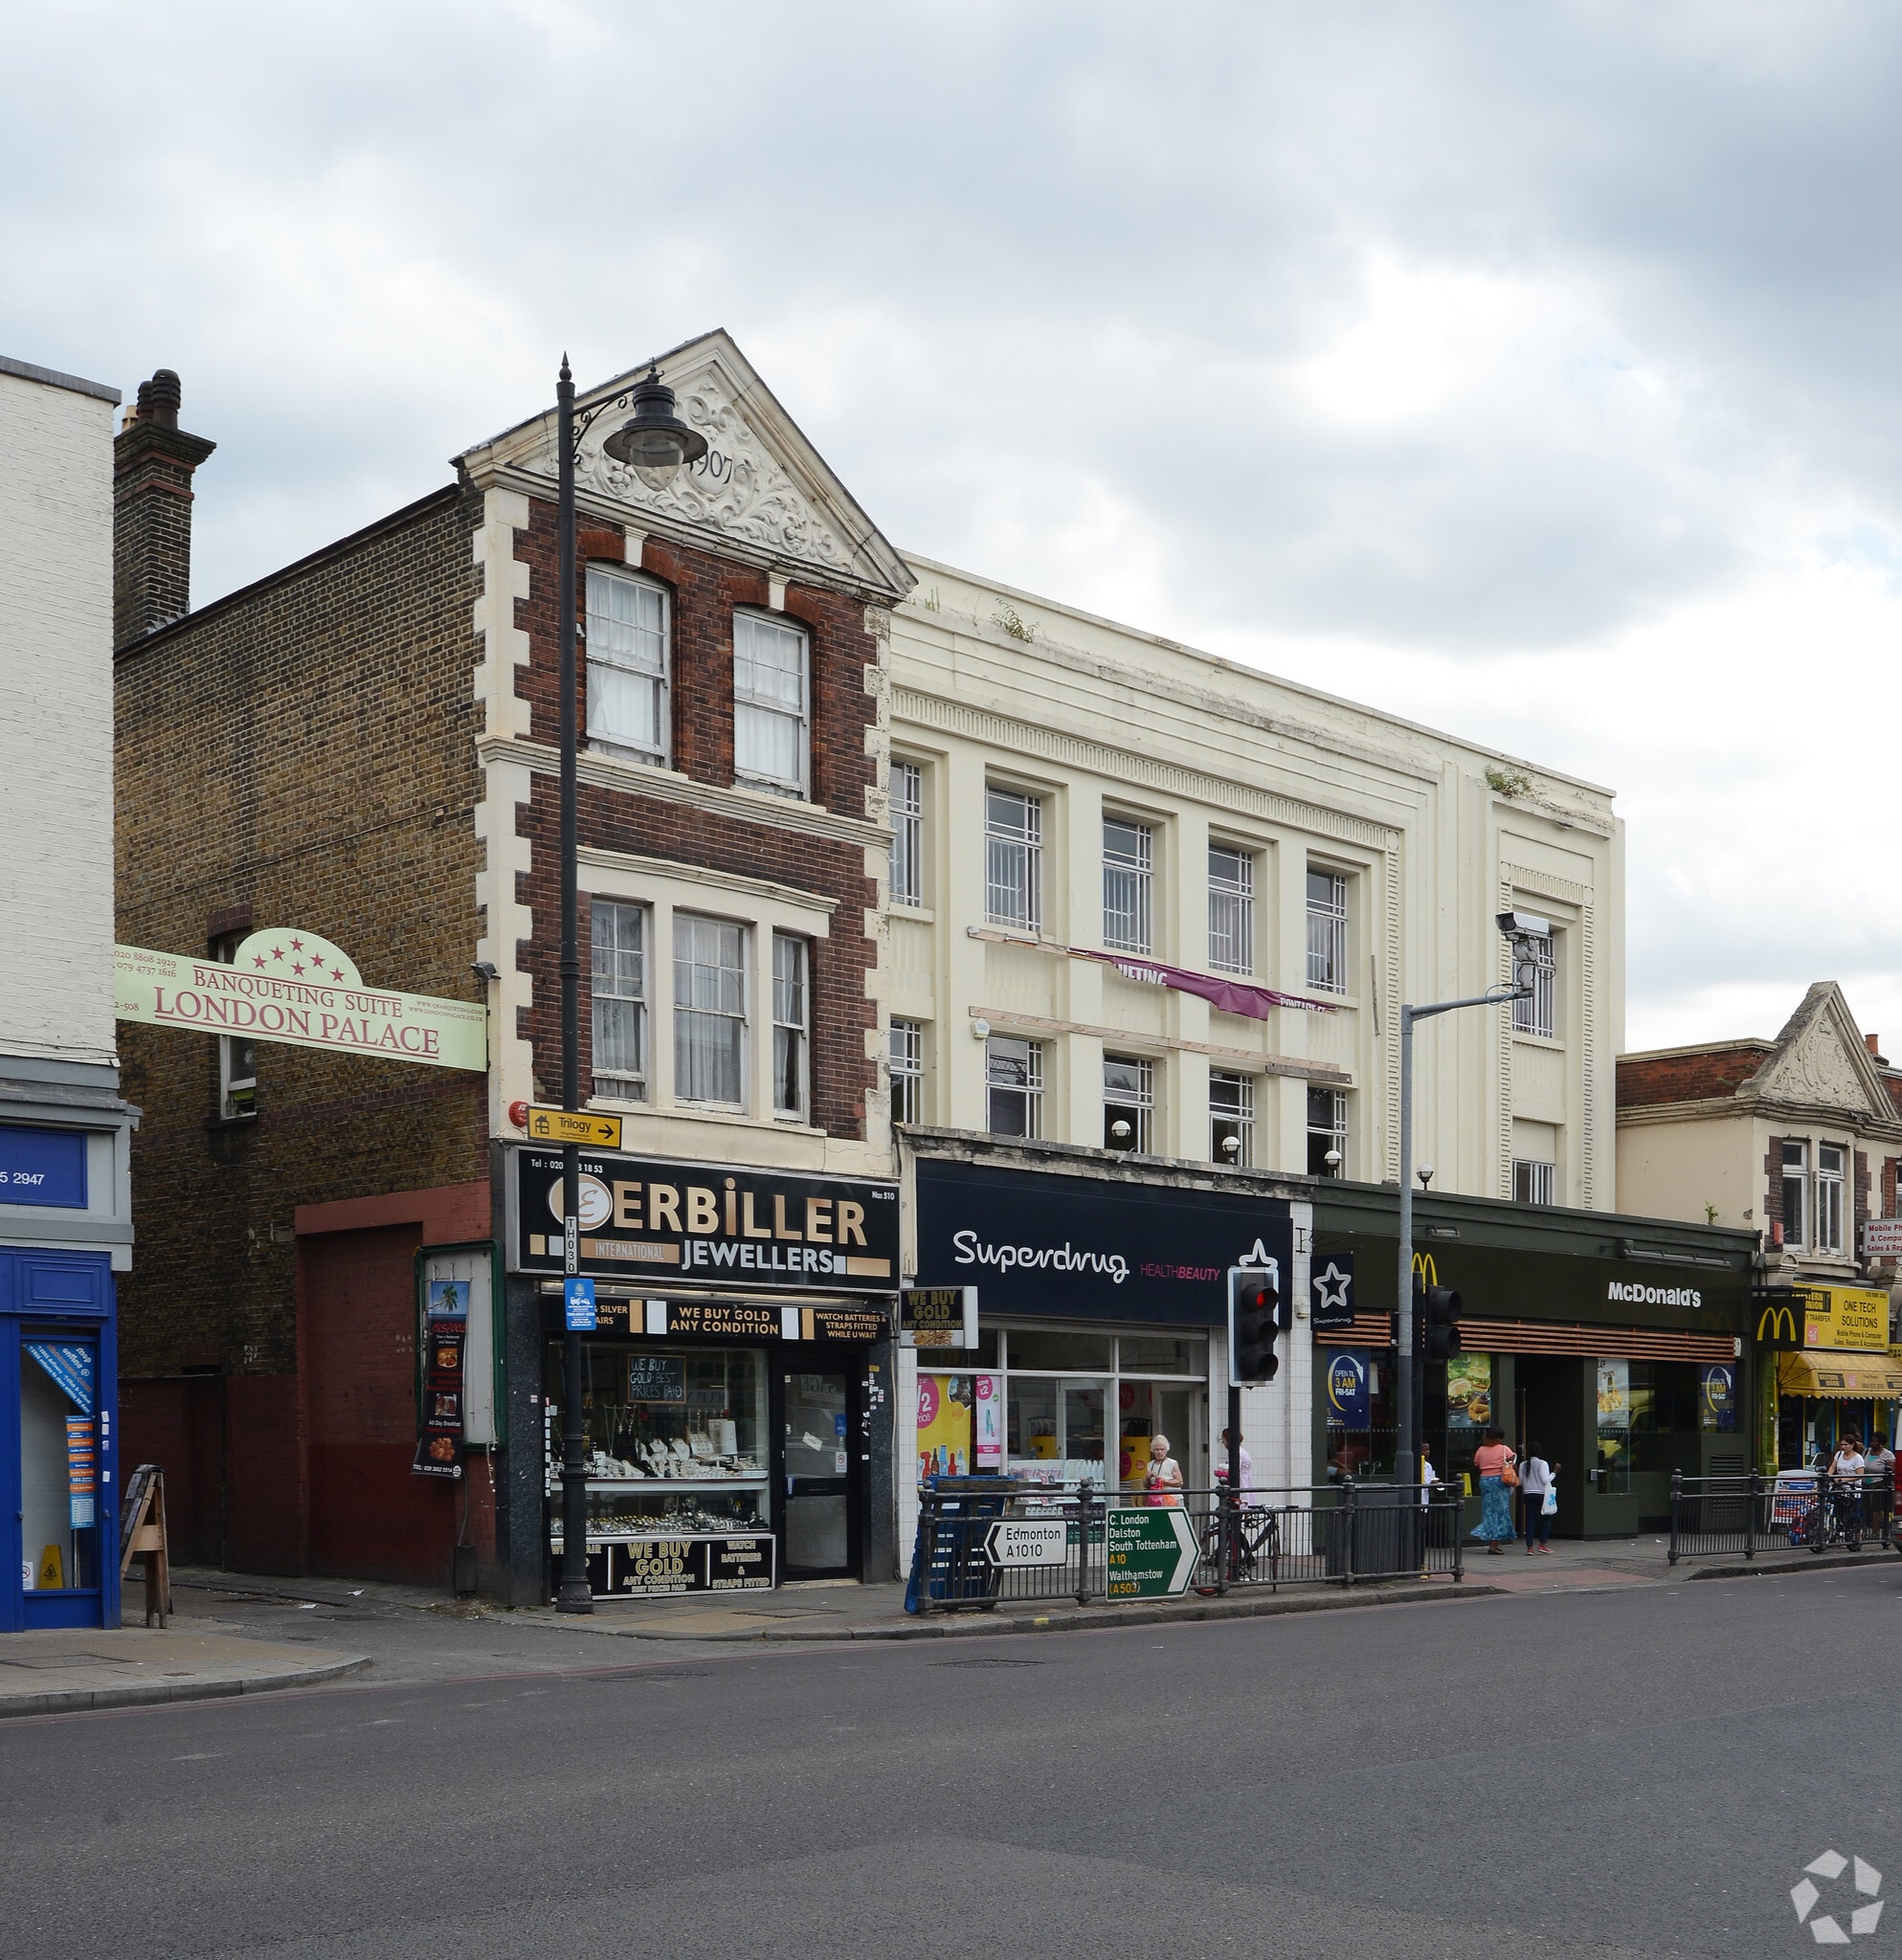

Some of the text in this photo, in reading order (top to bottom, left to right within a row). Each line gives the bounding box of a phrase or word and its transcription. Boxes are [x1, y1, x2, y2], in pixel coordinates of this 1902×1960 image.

[115, 950, 176, 969] 020 8808 2929
[118, 962, 176, 977] 079 4737 1616
[193, 969, 402, 1017] BANQUETING SUITE
[154, 986, 439, 1054] LONDON PALACE
[558, 1117, 592, 1133] Trilogy
[531, 1159, 542, 1168] Tel
[549, 1161, 564, 1169] 020
[584, 1164, 593, 1172] 18
[593, 1165, 603, 1173] 53
[12, 1172, 45, 1185] 2947
[884, 1192, 895, 1200] 510
[595, 1239, 833, 1273] INTERNATIONAL JEWELLERS
[953, 1230, 1130, 1283] Superdrug
[907, 1291, 956, 1305] WE BUY
[1608, 1281, 1701, 1308] McDonald's
[600, 1305, 628, 1314] SILVER
[913, 1305, 951, 1320] GOLD
[1844, 1301, 1876, 1313] ONE TECH
[679, 1307, 770, 1322] WE BUY GOLD
[844, 1314, 881, 1323] BATTERIES
[670, 1320, 778, 1334] ANY CONDITION
[826, 1322, 853, 1330] STRAPS
[920, 1320, 962, 1328] CONDITION
[1842, 1316, 1878, 1328] SOLUTIONS
[63, 1348, 82, 1369] online
[77, 1347, 91, 1363] shop
[632, 1359, 667, 1370] WE BUY
[1335, 1377, 1355, 1388] 3 AM
[632, 1385, 660, 1397] PRICES
[664, 1385, 682, 1398] PAID
[980, 1386, 989, 1395] £2
[1109, 1514, 1149, 1526] C. London
[1006, 1527, 1061, 1541] Edmonton
[1109, 1528, 1141, 1539] Dalston
[550, 1545, 602, 1554] WE AIR
[627, 1541, 692, 1559] WE BUY
[727, 1541, 756, 1549] WATCH
[1109, 1540, 1176, 1551] South Tottenham
[721, 1552, 762, 1563] BATTERIES
[1006, 1545, 1042, 1558] A1010
[1109, 1554, 1126, 1565] A10
[636, 1559, 683, 1575] GOLD
[738, 1566, 745, 1575] &
[623, 1574, 695, 1586] ANY CONDITION
[1109, 1570, 1163, 1581] Walthamstow
[712, 1577, 770, 1589] STRAPS FITTED
